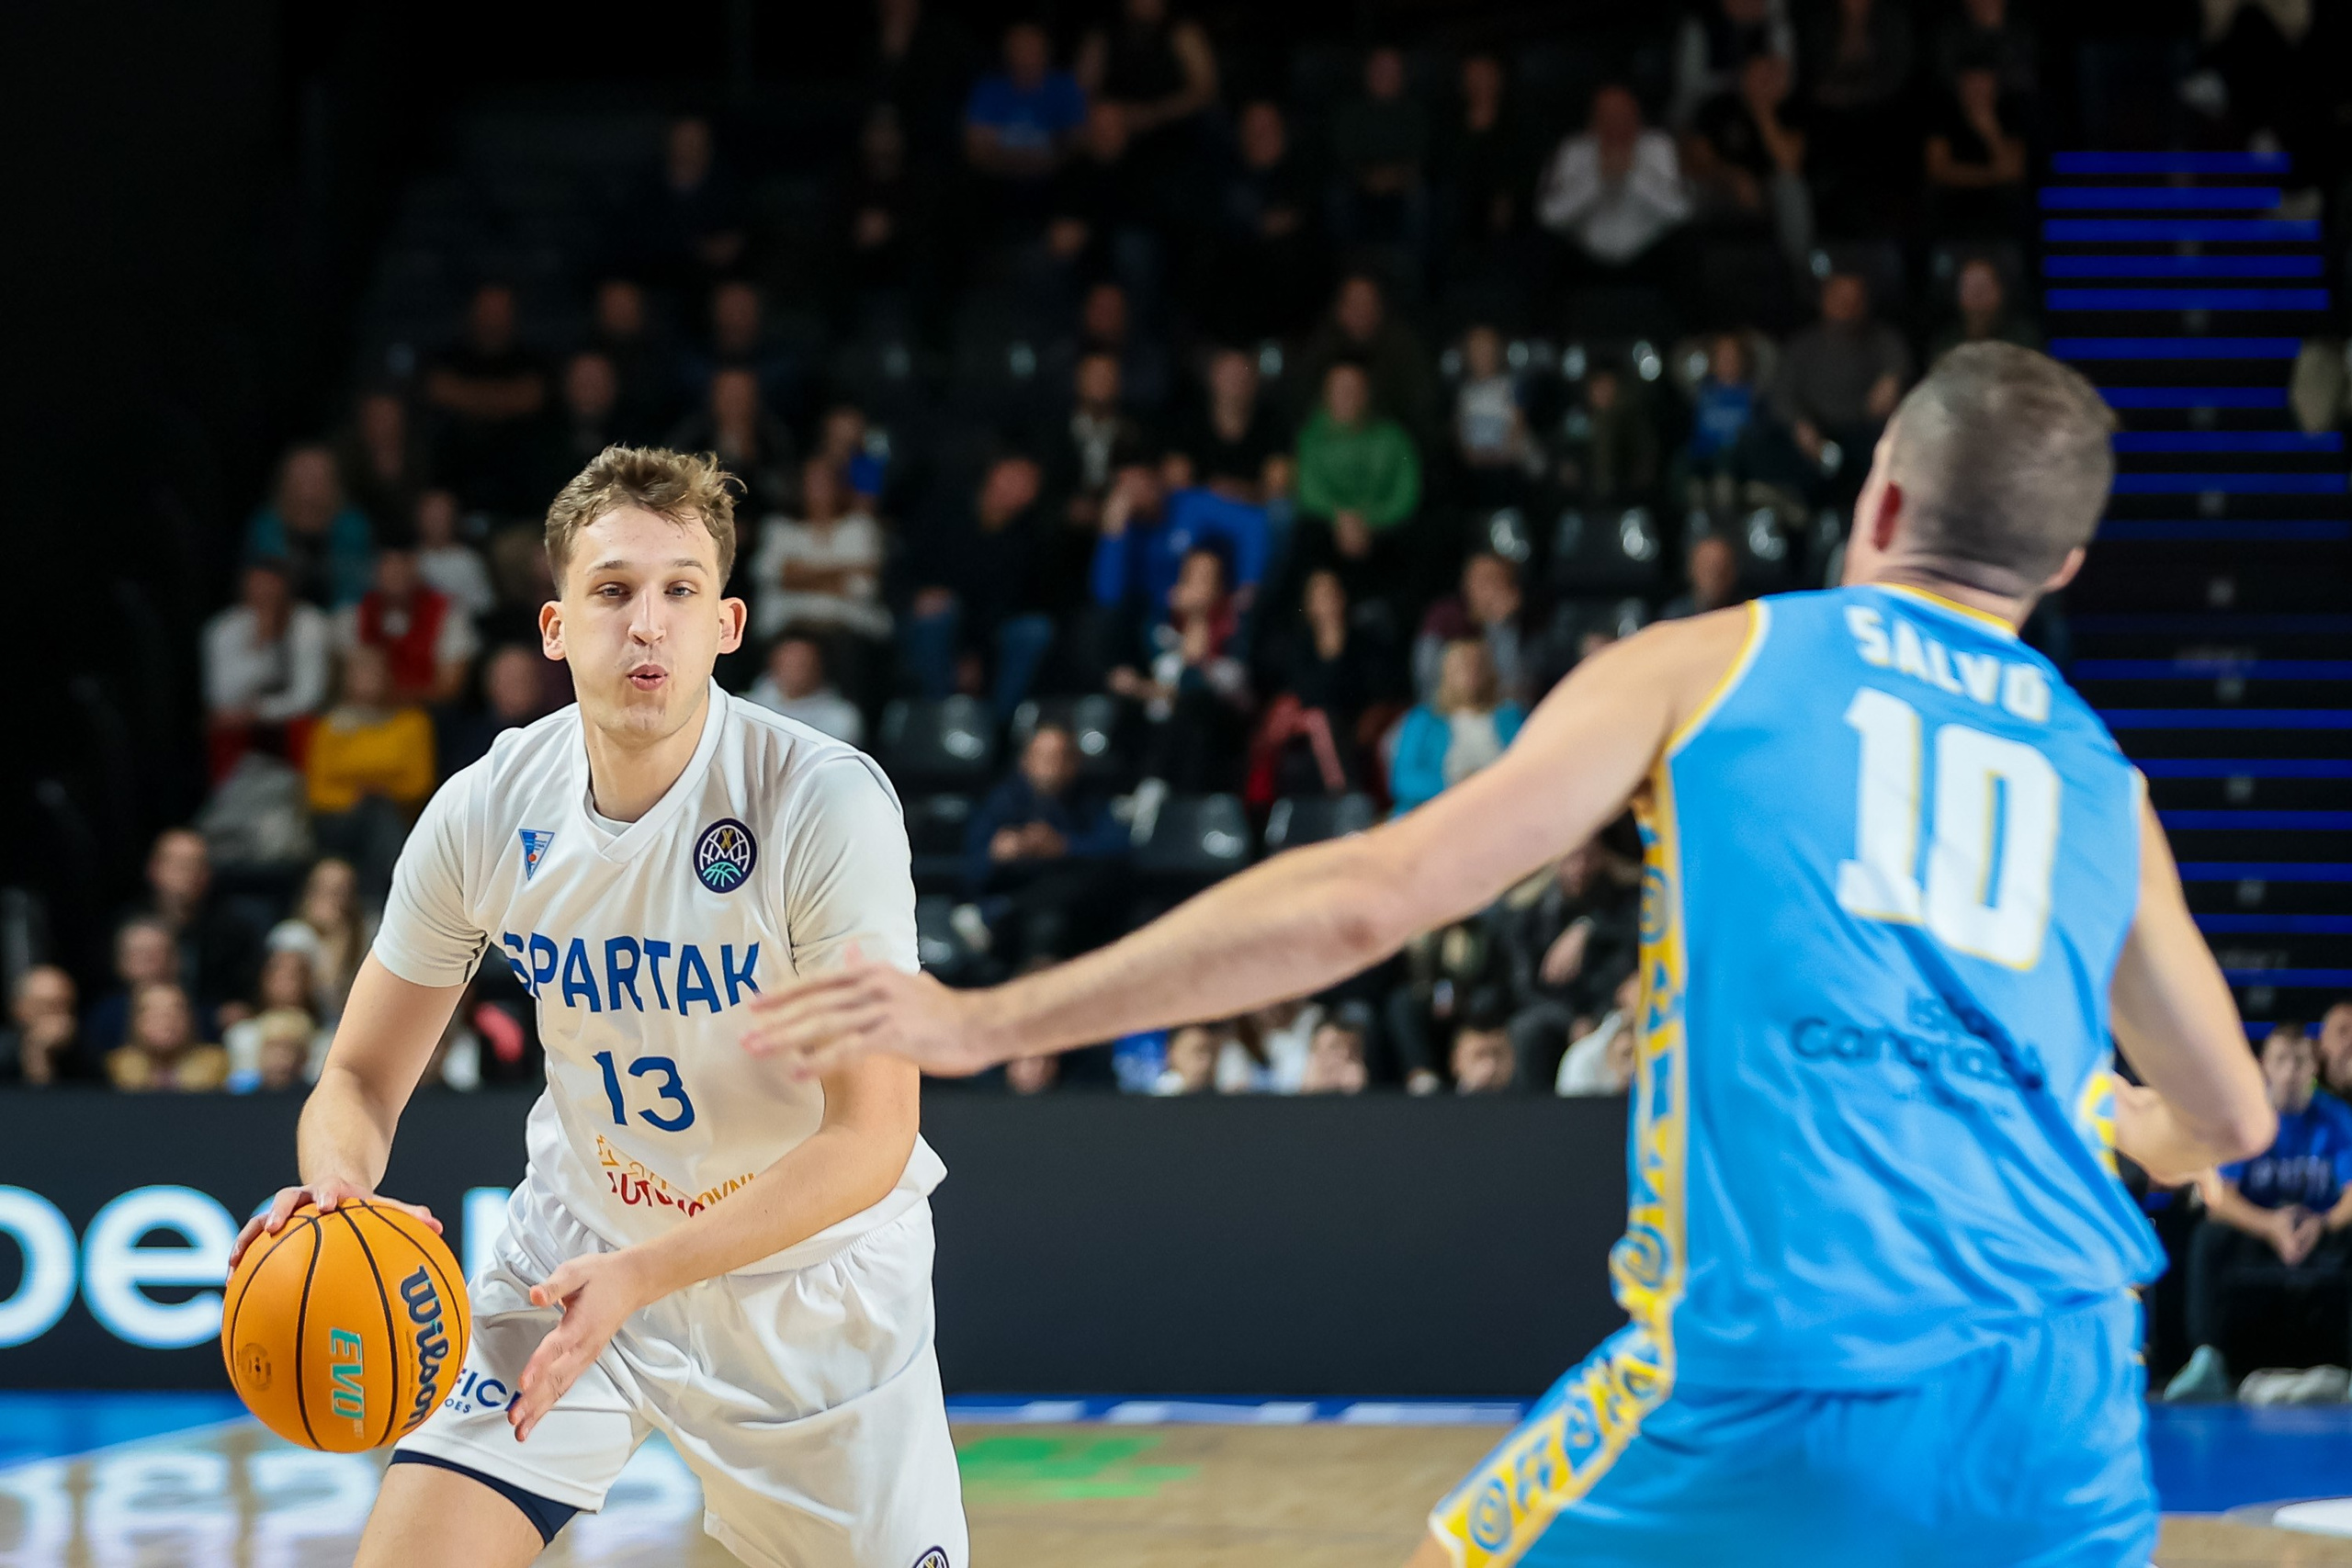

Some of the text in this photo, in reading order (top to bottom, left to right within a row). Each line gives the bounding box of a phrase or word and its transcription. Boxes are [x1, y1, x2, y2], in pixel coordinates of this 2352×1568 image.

[1842, 604, 2052, 723] SALVO
[1838, 686, 2062, 972] 10
[503, 931, 761, 1017] SPARTAK
[592, 1050, 695, 1133] 13
[329, 1325, 366, 1420] EVO
[400, 1264, 449, 1430] Wilson
